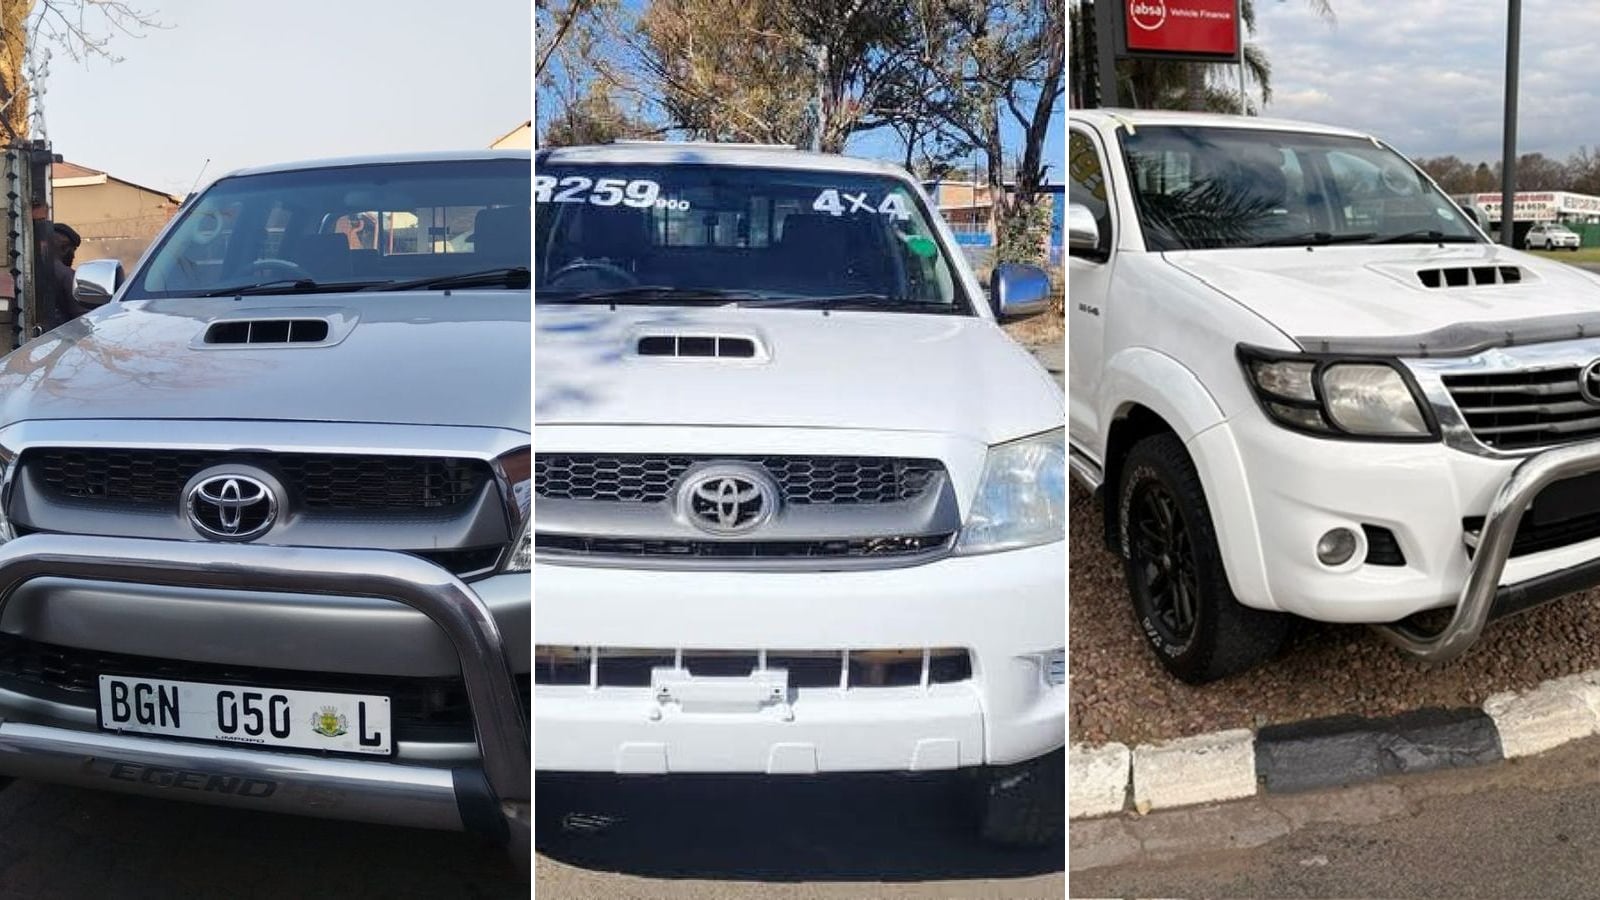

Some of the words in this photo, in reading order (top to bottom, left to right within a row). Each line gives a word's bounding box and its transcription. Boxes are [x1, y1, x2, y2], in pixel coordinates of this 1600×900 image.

[1135, 2, 1161, 16] absa
[1170, 8, 1198, 17] Vehicle
[1200, 9, 1230, 19] Finance
[110, 680, 181, 729] BGN
[216, 690, 291, 739] 050
[358, 701, 382, 747] L
[215, 735, 265, 743] LIMPOPO
